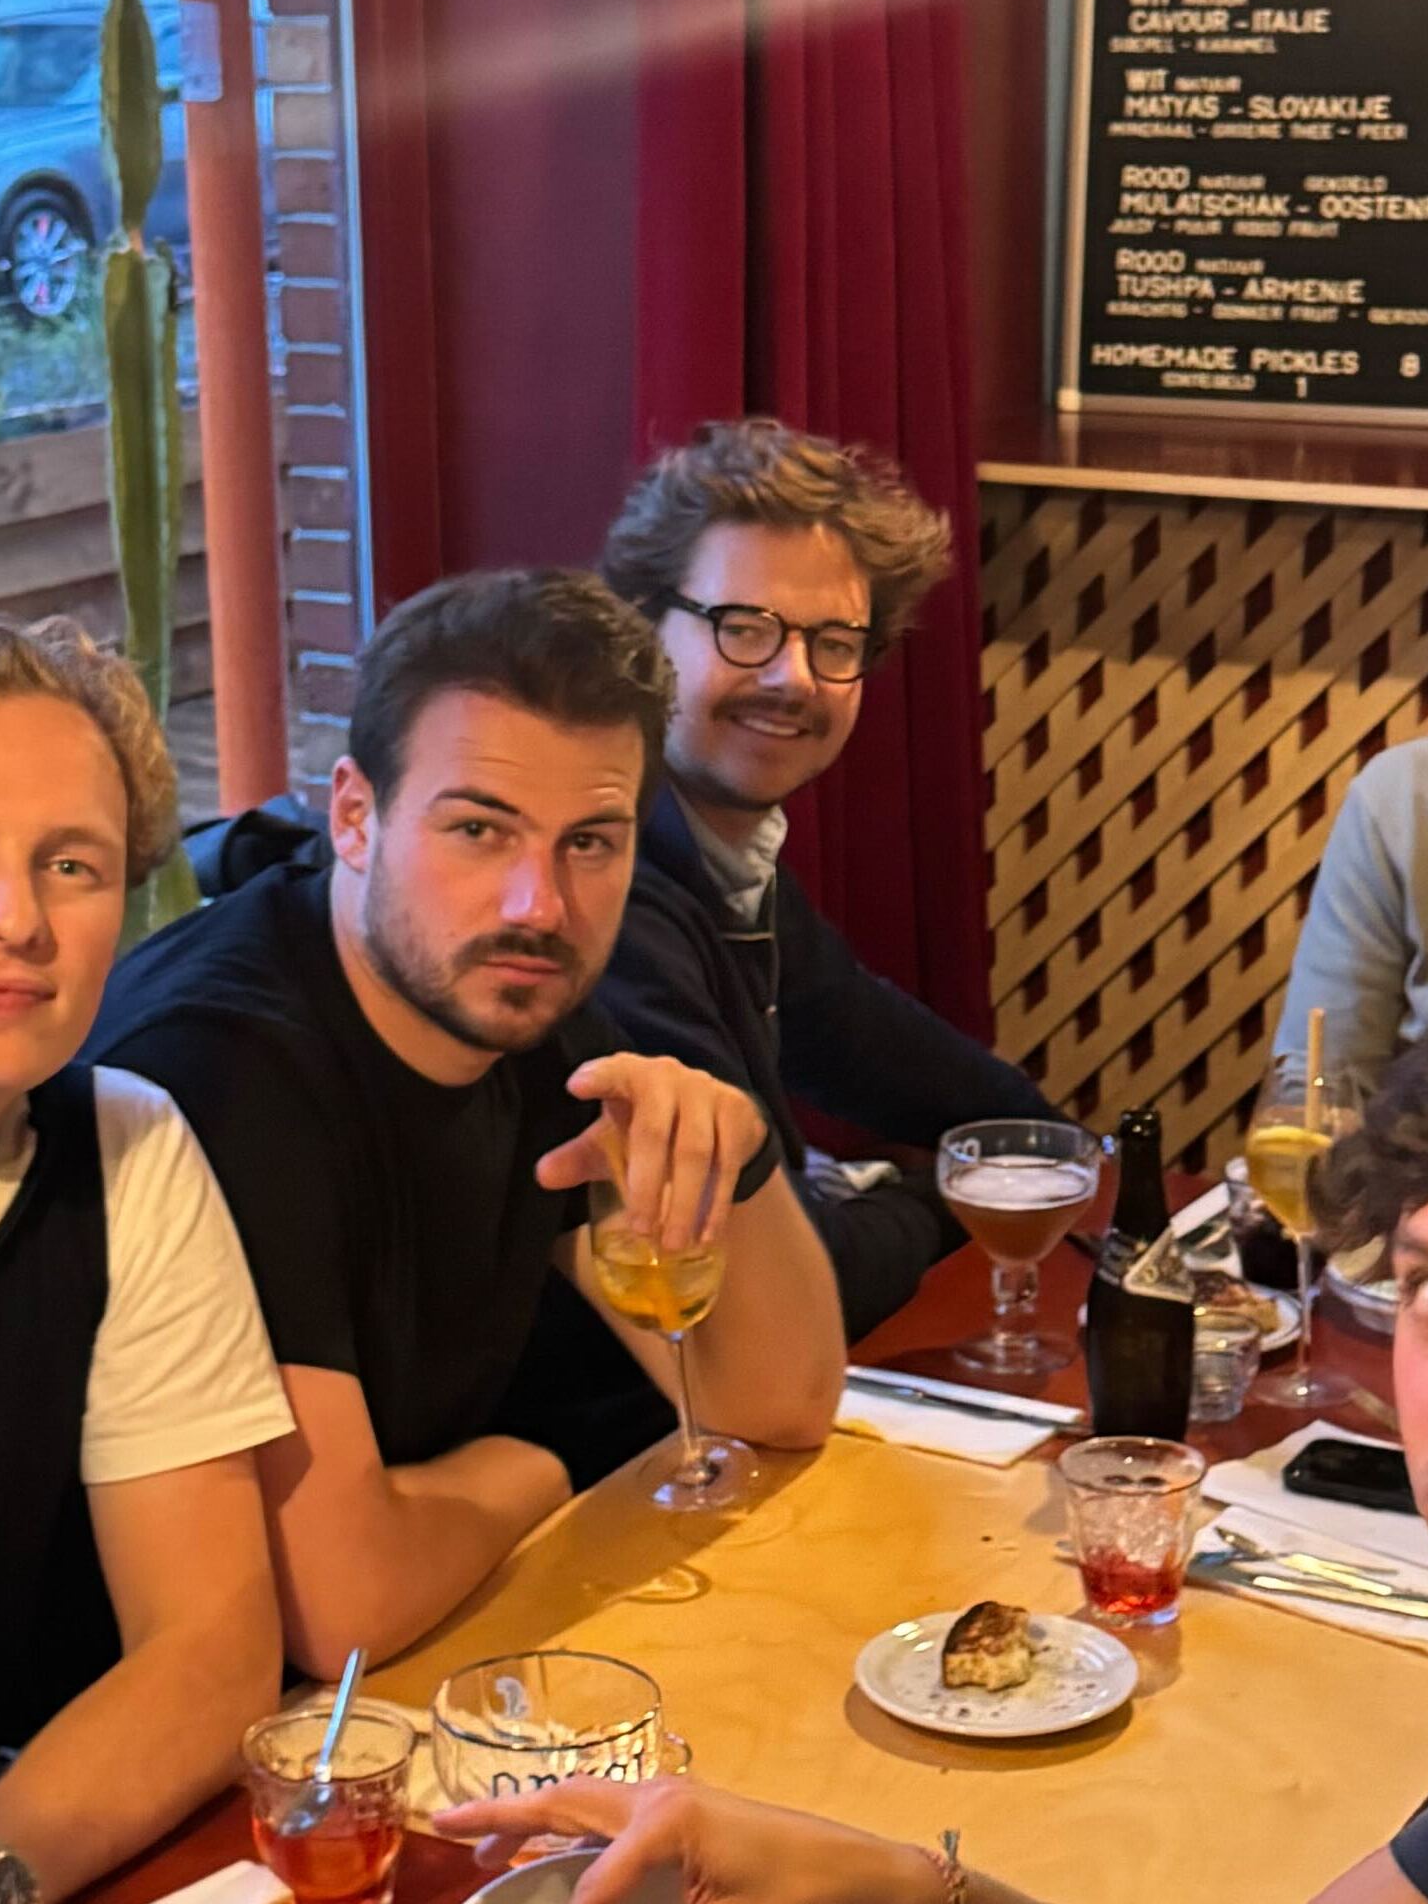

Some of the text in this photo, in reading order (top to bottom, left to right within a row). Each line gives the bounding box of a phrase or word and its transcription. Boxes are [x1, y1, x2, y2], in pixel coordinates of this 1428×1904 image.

[1129, 10, 1229, 34] CAVOUR
[1251, 8, 1332, 34] ITALIE
[1124, 68, 1169, 92] WIT
[1124, 95, 1220, 118] MATYAS
[1247, 95, 1392, 120] SLOVAKIJE
[1121, 165, 1191, 190] ROOD
[1119, 193, 1291, 218] MULATSCHAK
[1115, 248, 1186, 273] ROOD
[1116, 273, 1216, 299] TUSHPA
[1242, 278, 1367, 304] ARMENIE
[1090, 344, 1421, 378] HOMEMADE PICKLES 8
